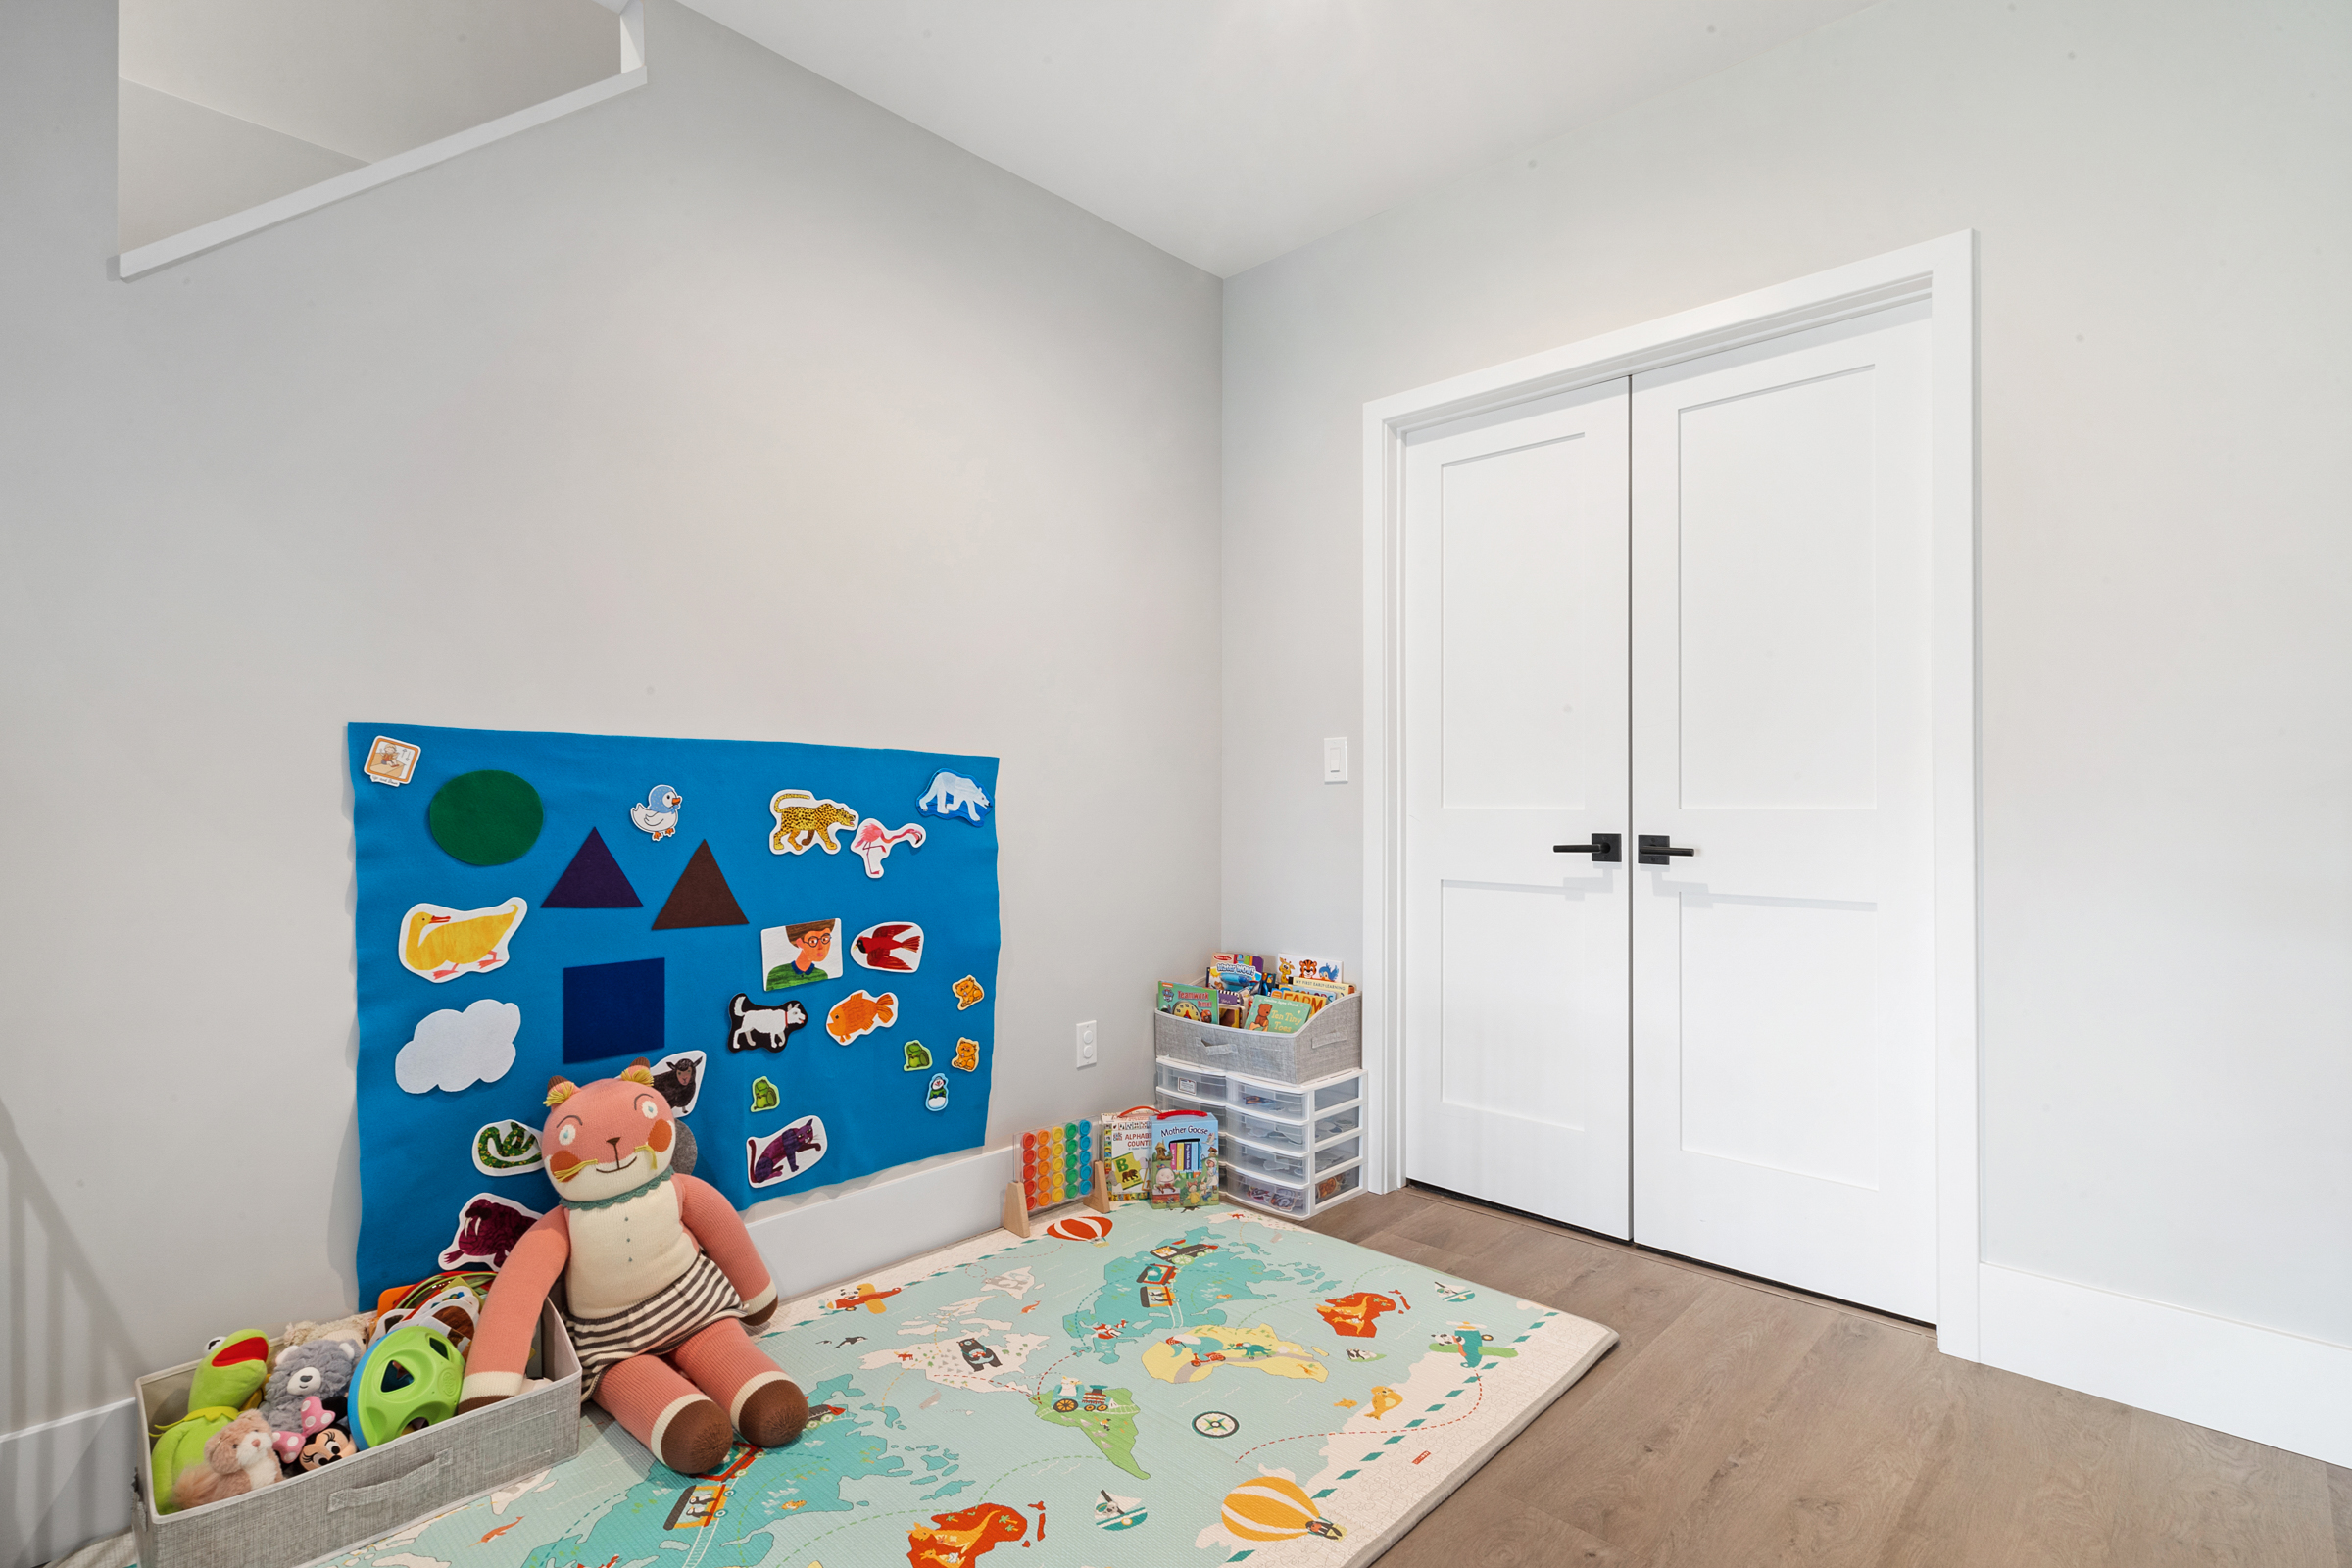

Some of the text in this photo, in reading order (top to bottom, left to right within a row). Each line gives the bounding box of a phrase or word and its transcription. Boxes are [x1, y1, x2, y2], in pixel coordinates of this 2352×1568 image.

[1217, 963, 1235, 972] Water
[1177, 991, 1209, 1000] Teamwork
[1271, 1010, 1303, 1026] Ten Tiny
[1274, 1021, 1292, 1032] Toes
[1161, 1125, 1208, 1137] Mother Goose
[1116, 1158, 1129, 1172] B
